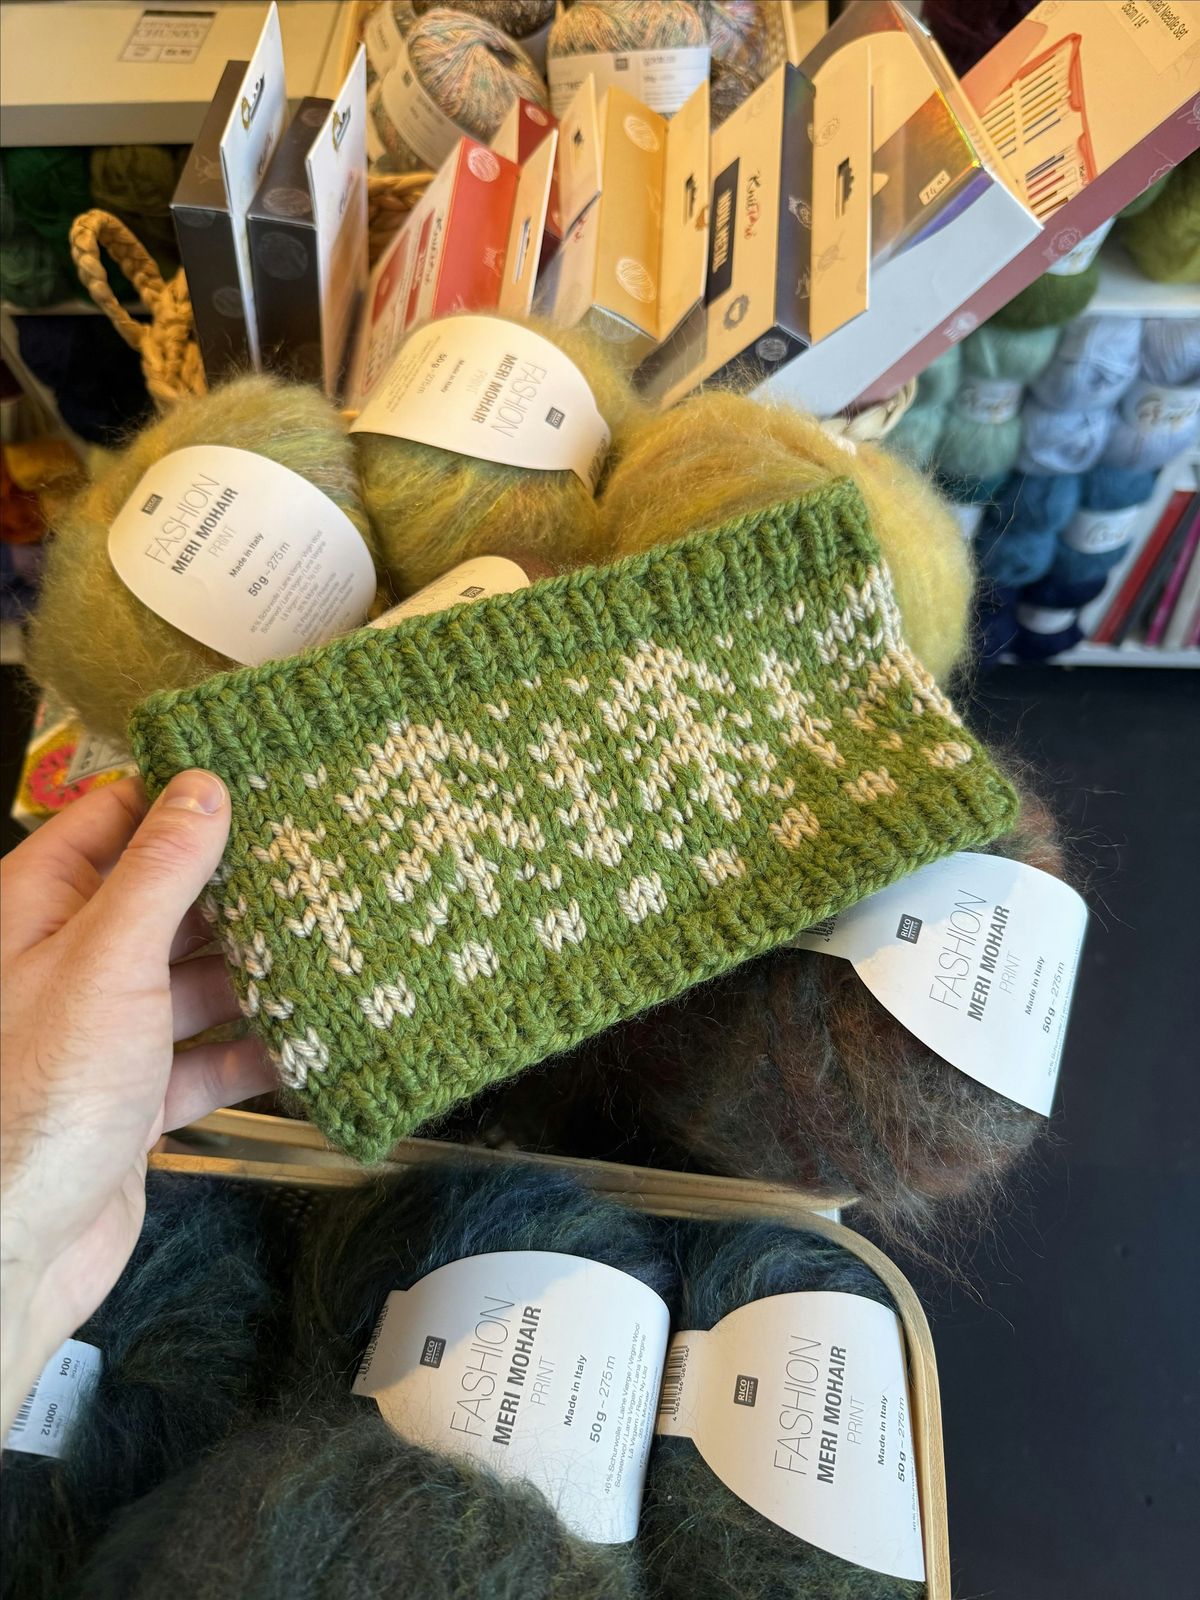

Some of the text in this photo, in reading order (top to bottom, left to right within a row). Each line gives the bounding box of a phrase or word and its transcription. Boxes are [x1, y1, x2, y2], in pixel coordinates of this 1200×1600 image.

[1173, 23, 1189, 40] Set
[471, 354, 518, 424] MERI MOHAIR
[491, 361, 547, 438] FASHION
[145, 473, 219, 564] FASHION
[171, 488, 239, 574] MERI MOHAIR
[209, 527, 237, 557] PRINT
[229, 555, 245, 577] Made
[250, 532, 264, 551] Italy
[248, 580, 262, 598] 50
[268, 551, 284, 572] 275
[280, 541, 290, 554] m
[900, 918, 911, 937] RICO
[929, 889, 987, 1010] FASHION
[967, 904, 1010, 1021] MERI MOHAIR
[1000, 952, 1021, 994] PRINT
[1057, 961, 1065, 974] m
[1025, 991, 1035, 1015] Made
[1034, 956, 1045, 977] Italy
[1051, 976, 1061, 998] 275
[1042, 1015, 1053, 1033] 50
[1047, 1006, 1057, 1017] g
[630, 1321, 641, 1343] Wool
[423, 1339, 436, 1362] RICO
[606, 1355, 615, 1369] m
[627, 1343, 639, 1365] Virgin
[60, 1357, 71, 1376] 004
[450, 1296, 515, 1437] FASHION
[493, 1306, 541, 1446] MERI MOHAIR
[530, 1356, 555, 1406] PRINT
[564, 1354, 587, 1426] Made in Italy
[599, 1370, 612, 1398] 275
[738, 1378, 747, 1402] RICO
[596, 1410, 607, 1423] g
[617, 1396, 628, 1419] Laine
[774, 1335, 821, 1474] FASHION
[818, 1345, 846, 1484] MERI MOHAIR
[880, 1395, 888, 1423] Italy
[898, 1397, 905, 1410] m
[41, 1403, 58, 1436] 00012
[589, 1423, 602, 1443] 50
[848, 1396, 865, 1444] PRINT
[879, 1426, 885, 1436] in
[898, 1413, 906, 1435] 275
[606, 1425, 623, 1472] Schurwolle
[898, 1451, 906, 1463] g
[897, 1462, 906, 1482] 50
